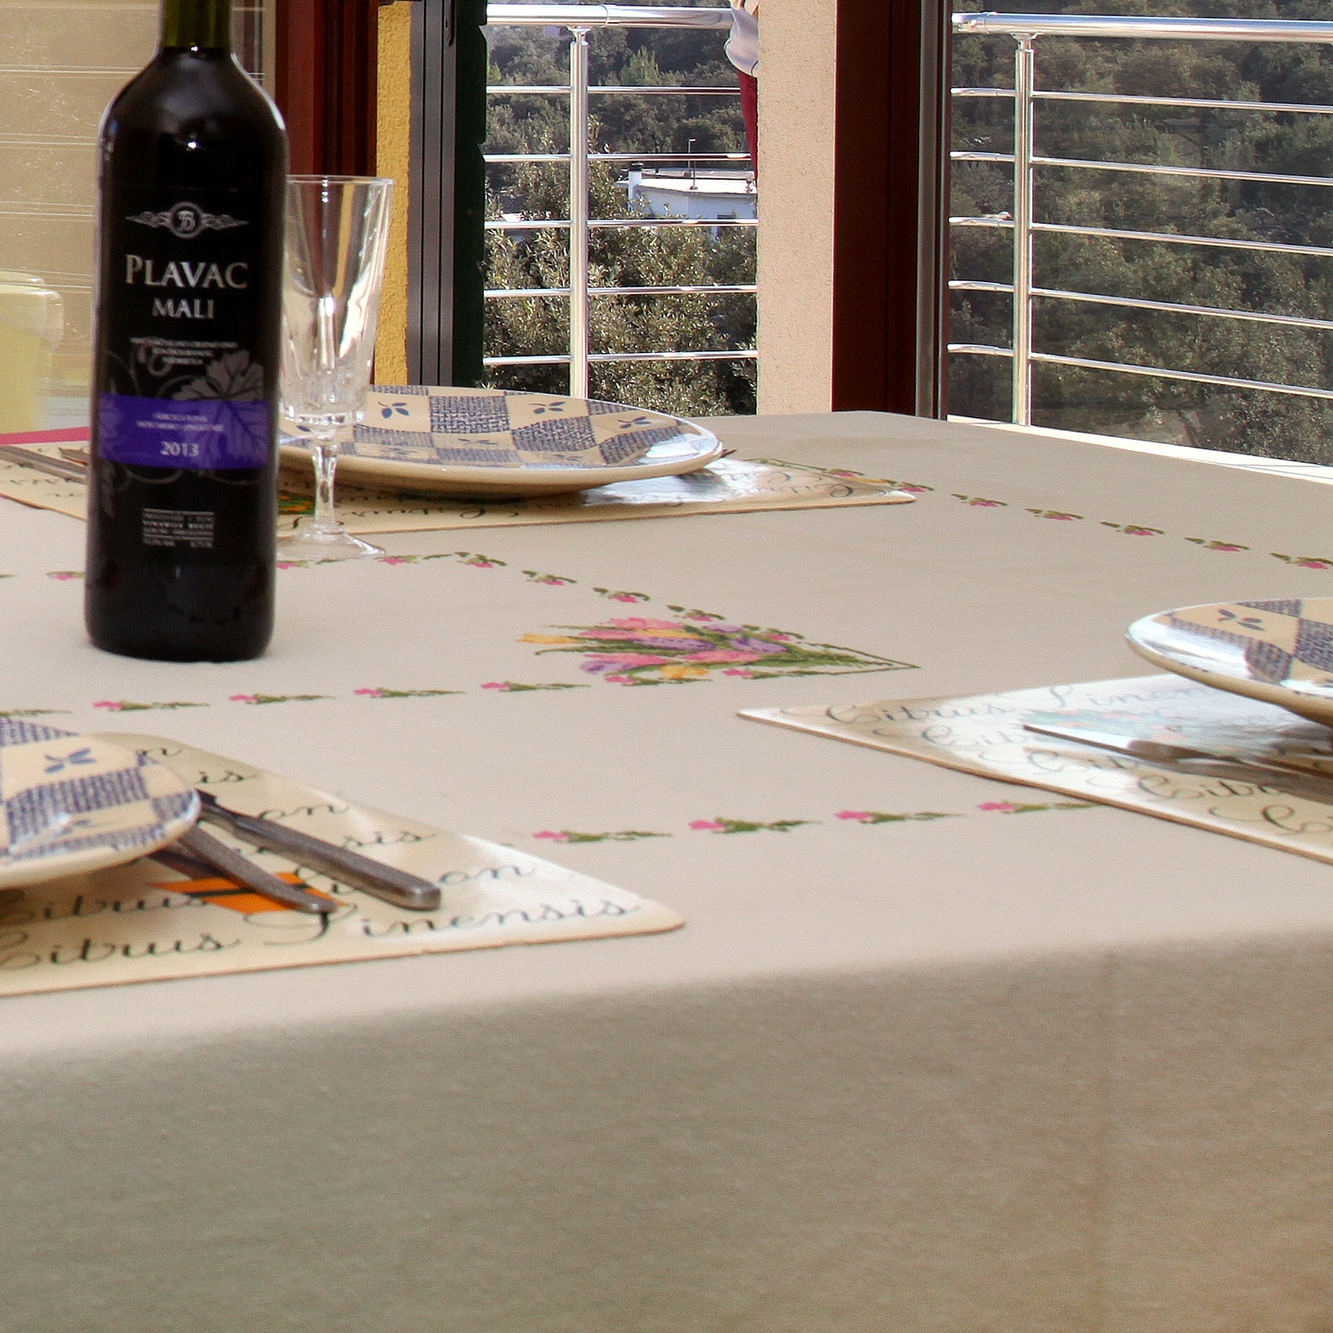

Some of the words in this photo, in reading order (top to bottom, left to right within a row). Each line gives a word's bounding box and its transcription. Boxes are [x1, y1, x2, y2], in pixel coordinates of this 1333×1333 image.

[126, 254, 249, 289] PLAVAC
[152, 297, 215, 319] MALI
[160, 440, 200, 457] 2013
